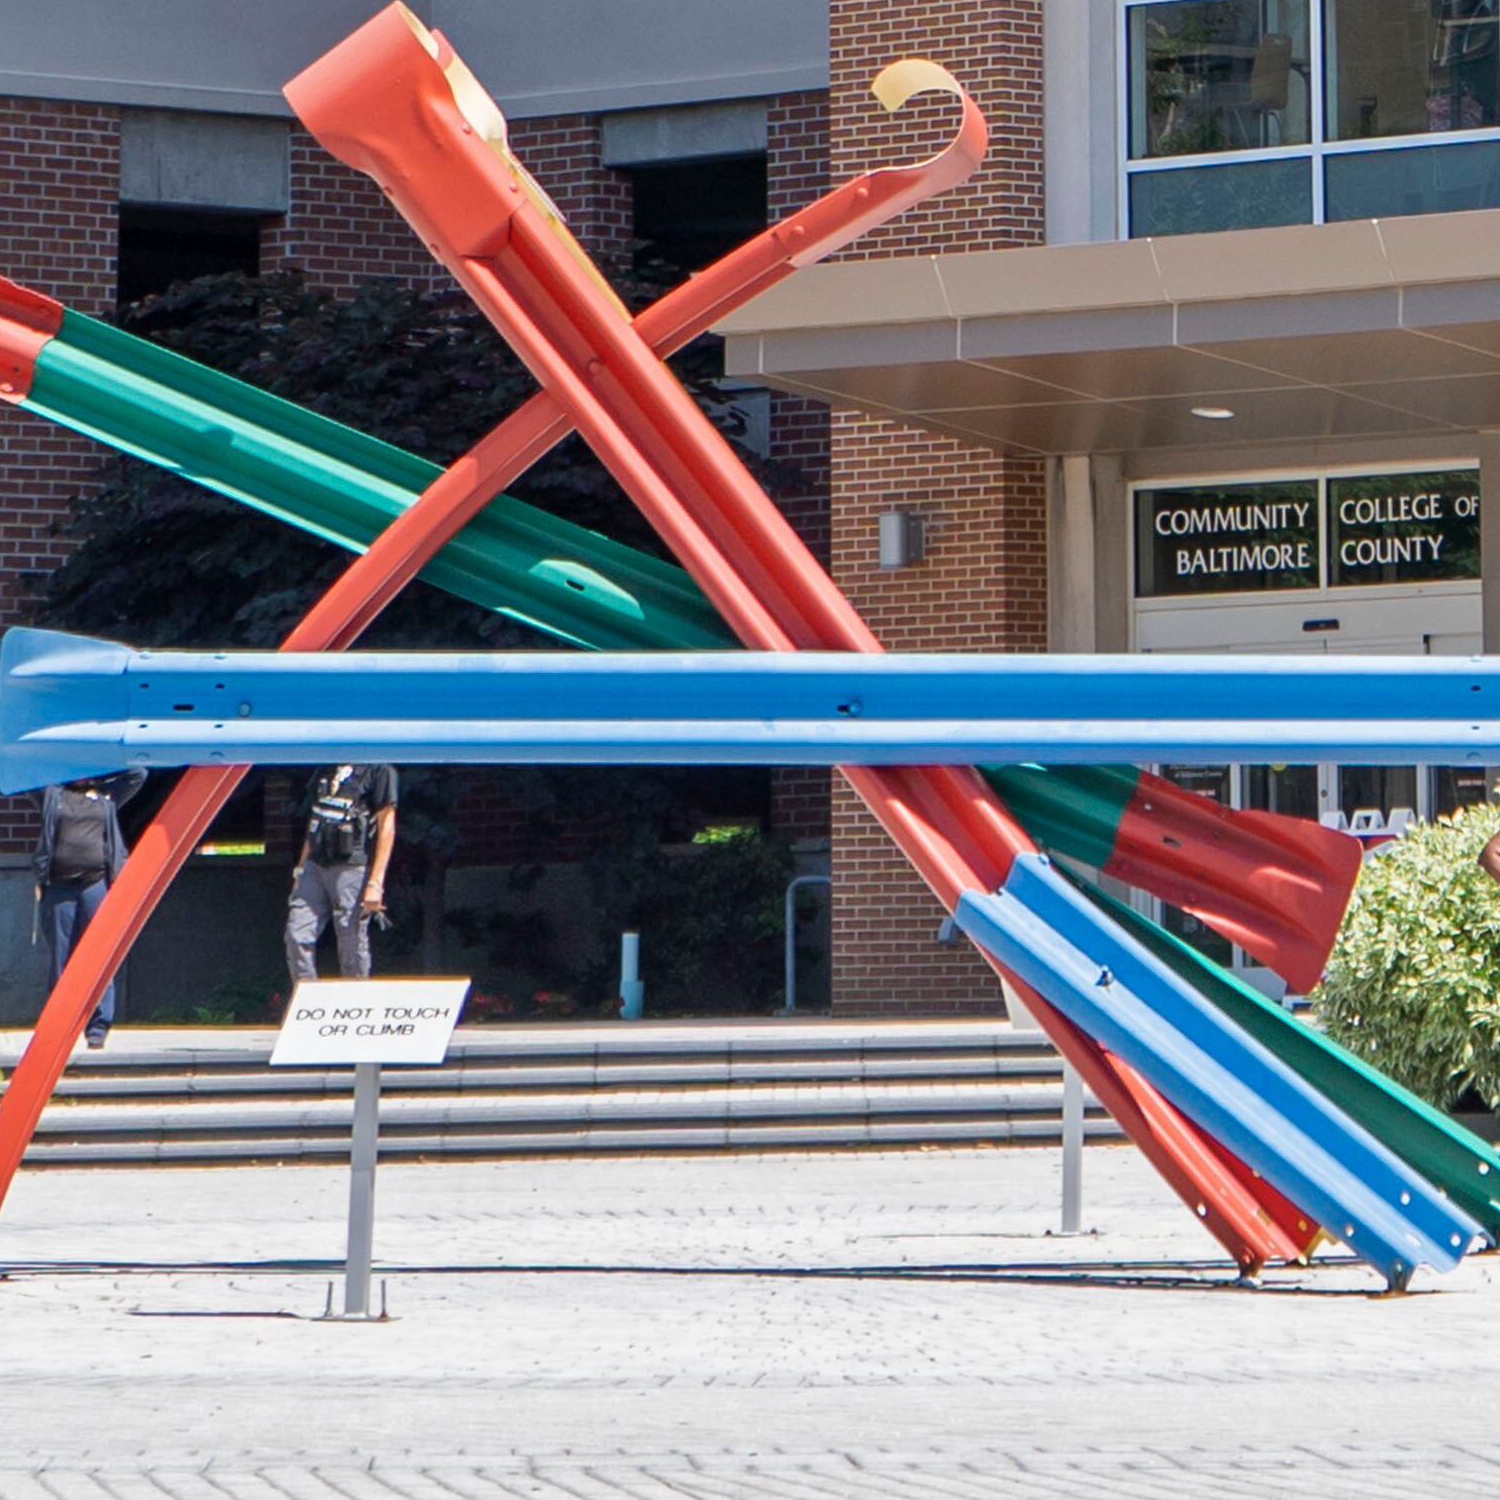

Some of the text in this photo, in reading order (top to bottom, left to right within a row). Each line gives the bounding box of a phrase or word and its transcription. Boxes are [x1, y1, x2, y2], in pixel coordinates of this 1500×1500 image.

[1155, 495, 1480, 535] COMMUNITY COLLEGE OF
[1176, 535, 1444, 575] BALTIMORE COUNTY
[295, 1007, 450, 1021] DO NOT TOUCH
[318, 1024, 415, 1037] OR CLIMB
